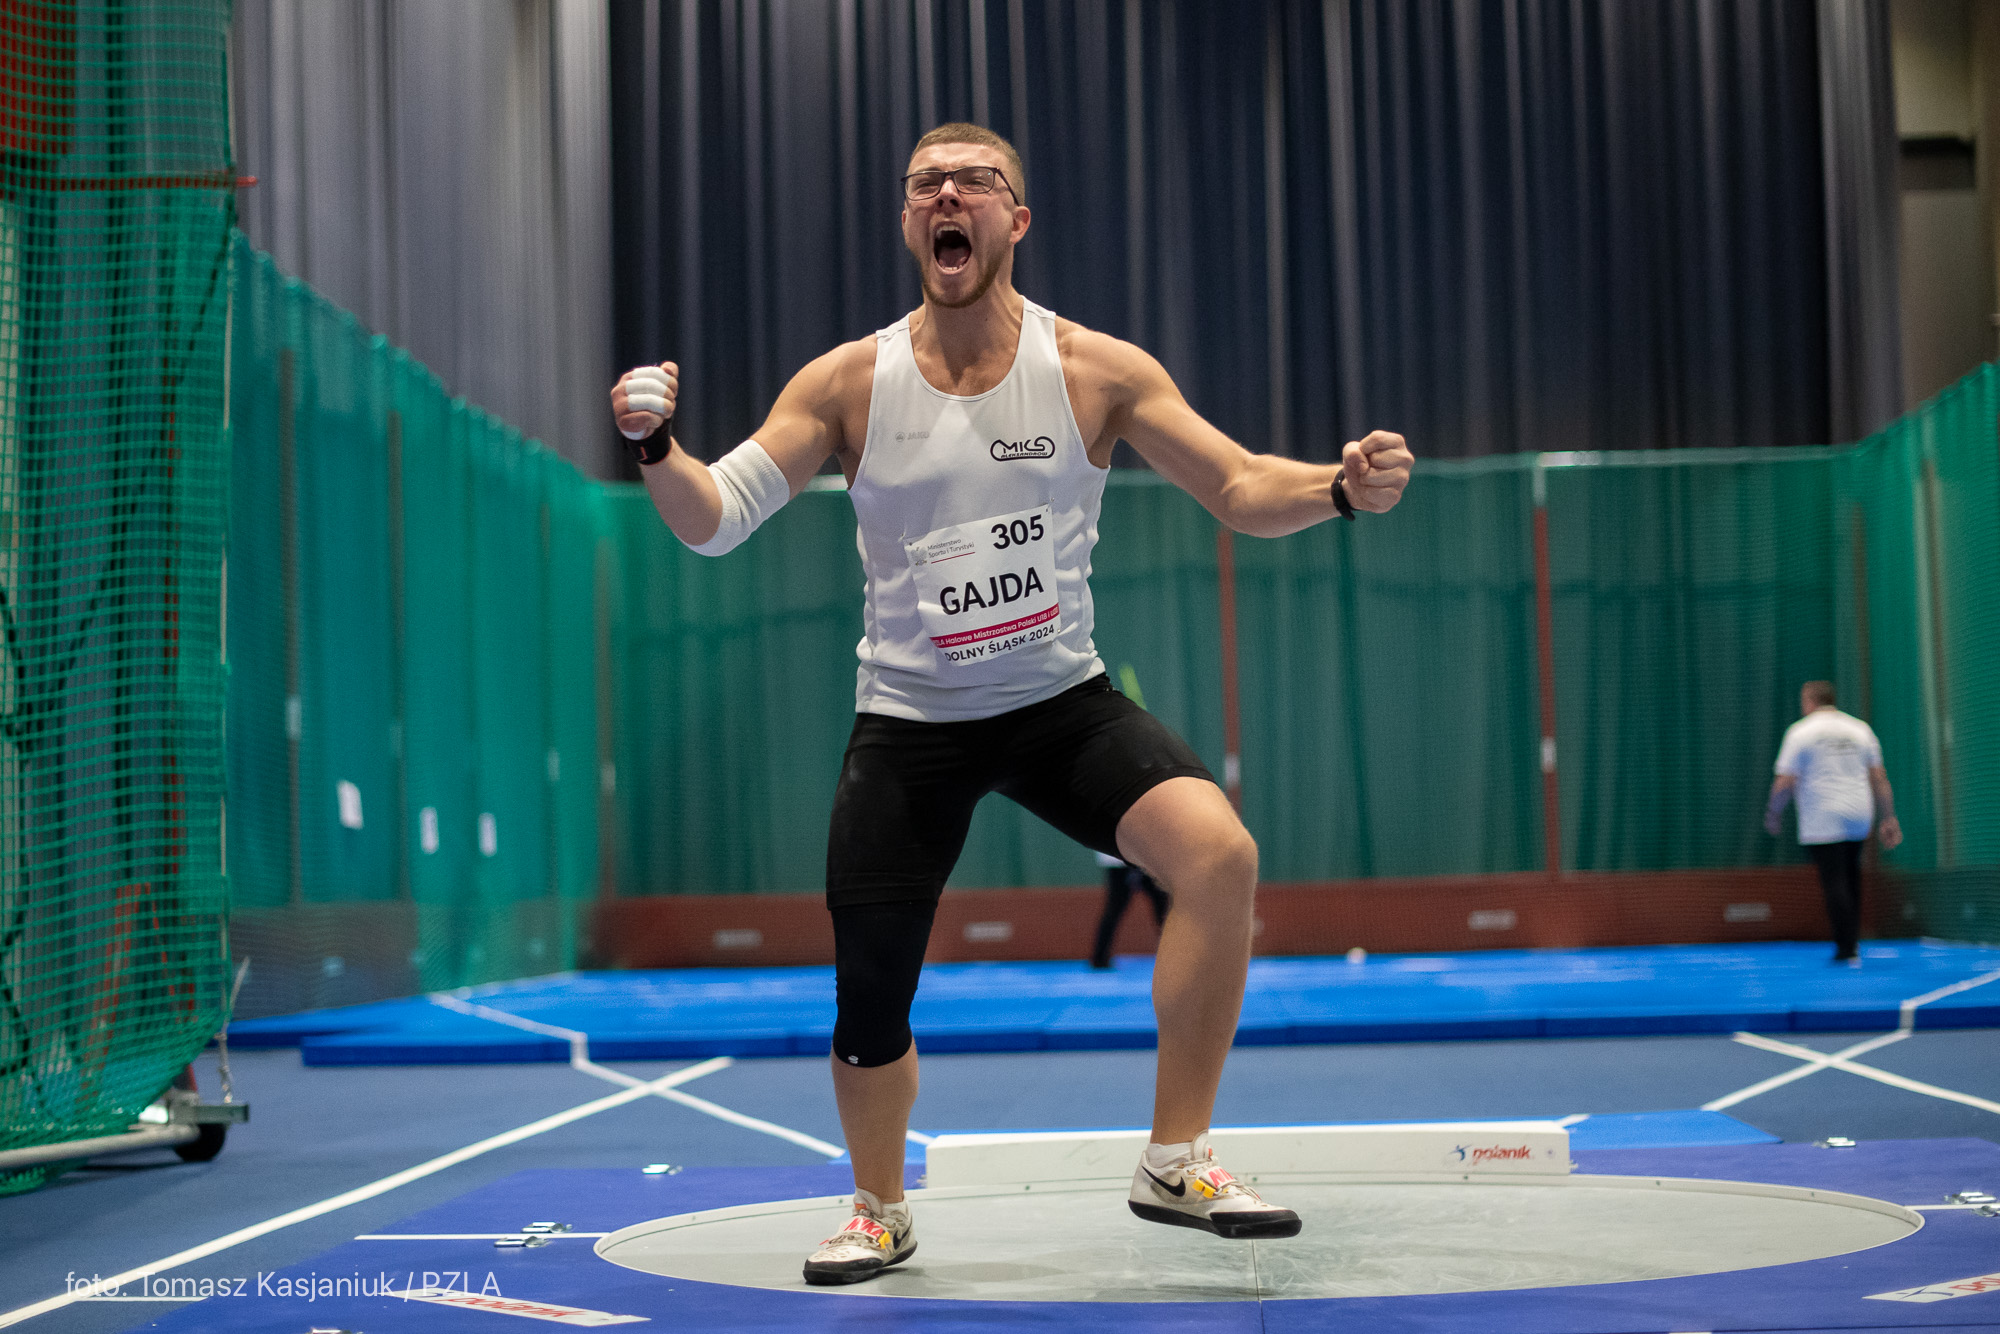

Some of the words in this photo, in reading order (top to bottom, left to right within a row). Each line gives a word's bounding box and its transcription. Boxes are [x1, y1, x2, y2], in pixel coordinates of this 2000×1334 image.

[927, 538, 961, 551] Ministerstwo
[991, 514, 1044, 550] 305
[928, 549, 946, 558] Sportu
[950, 542, 975, 553] Turystyki
[940, 566, 1044, 615] GAJDA
[945, 645, 985, 661] DOLNY
[988, 634, 1026, 654] ŚLĄSK
[1029, 624, 1054, 641] 2024
[946, 634, 972, 645] Halowe
[973, 624, 1017, 640] Mistrzostwa
[1018, 616, 1036, 628] Polski
